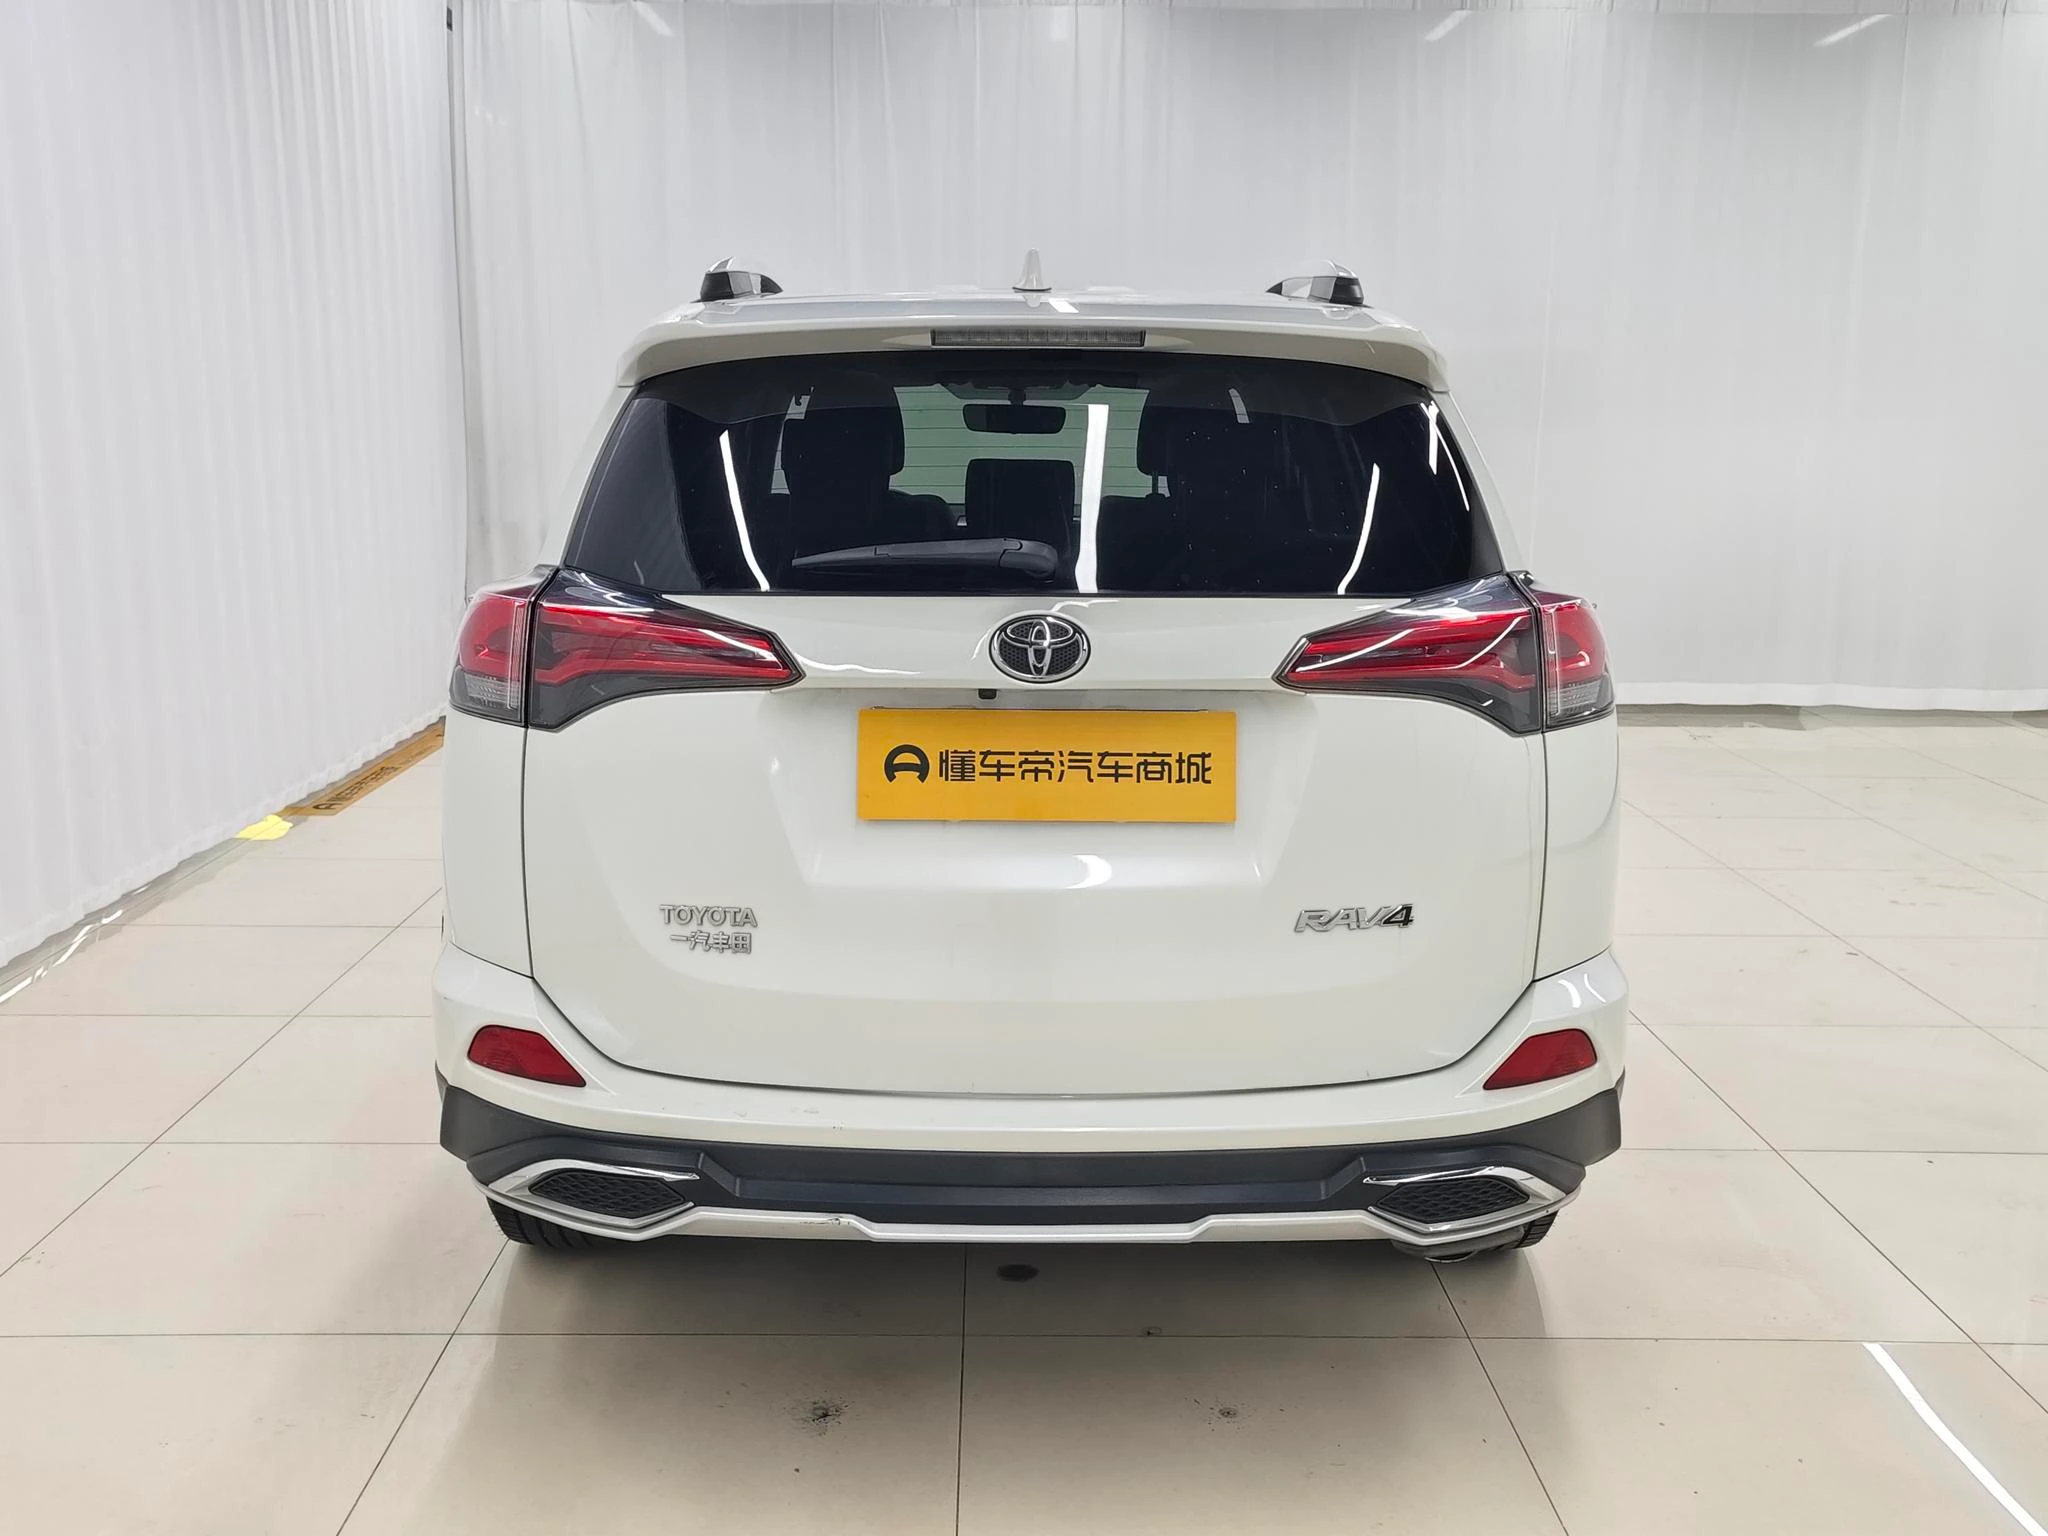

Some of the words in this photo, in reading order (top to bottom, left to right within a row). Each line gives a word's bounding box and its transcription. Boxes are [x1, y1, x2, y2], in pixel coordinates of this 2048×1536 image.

[938, 749, 1212, 785] 懂车帝汽车商城
[659, 904, 758, 928] TOYOTA
[1294, 903, 1414, 932] RAV4
[670, 930, 752, 954] 一汽丰田
